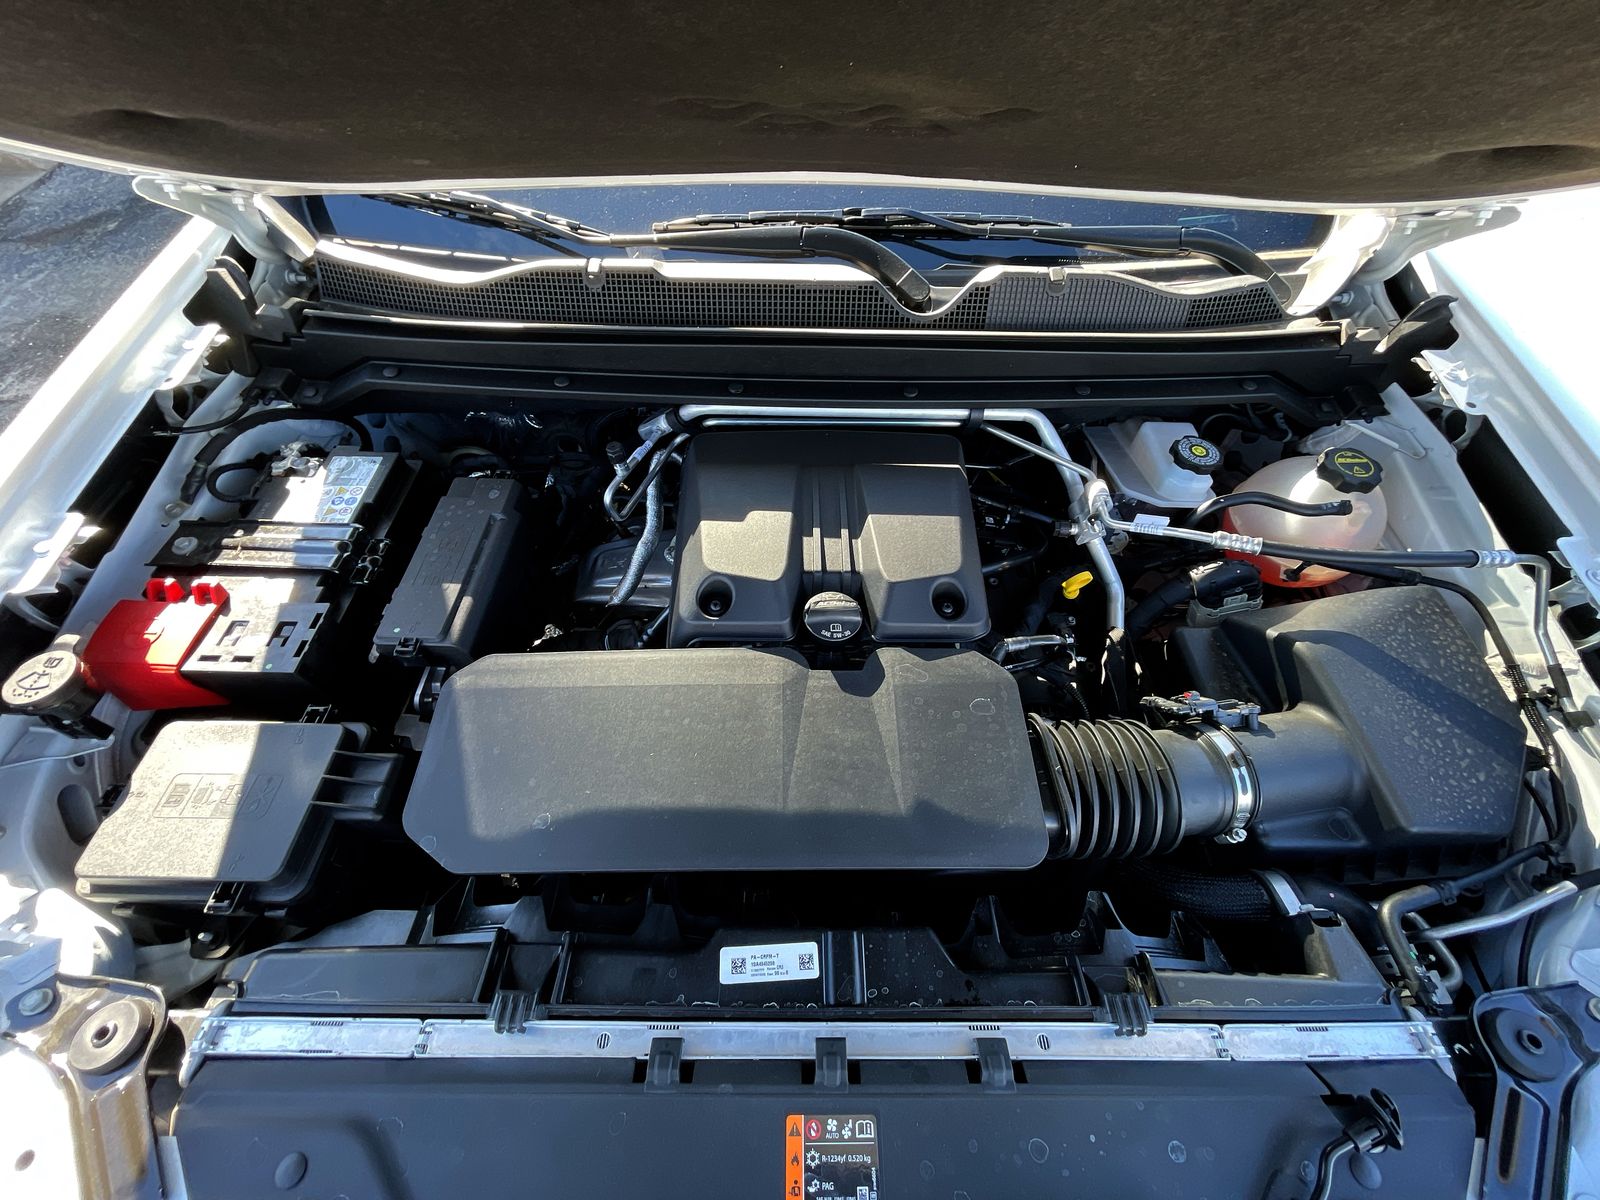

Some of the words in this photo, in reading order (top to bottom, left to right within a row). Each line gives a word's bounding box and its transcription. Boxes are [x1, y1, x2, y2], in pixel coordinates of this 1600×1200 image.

[833, 630, 851, 638] 5W-30
[821, 1155, 846, 1164] R-1234yf
[864, 1153, 871, 1164] kg
[822, 1182, 834, 1190] PAG
